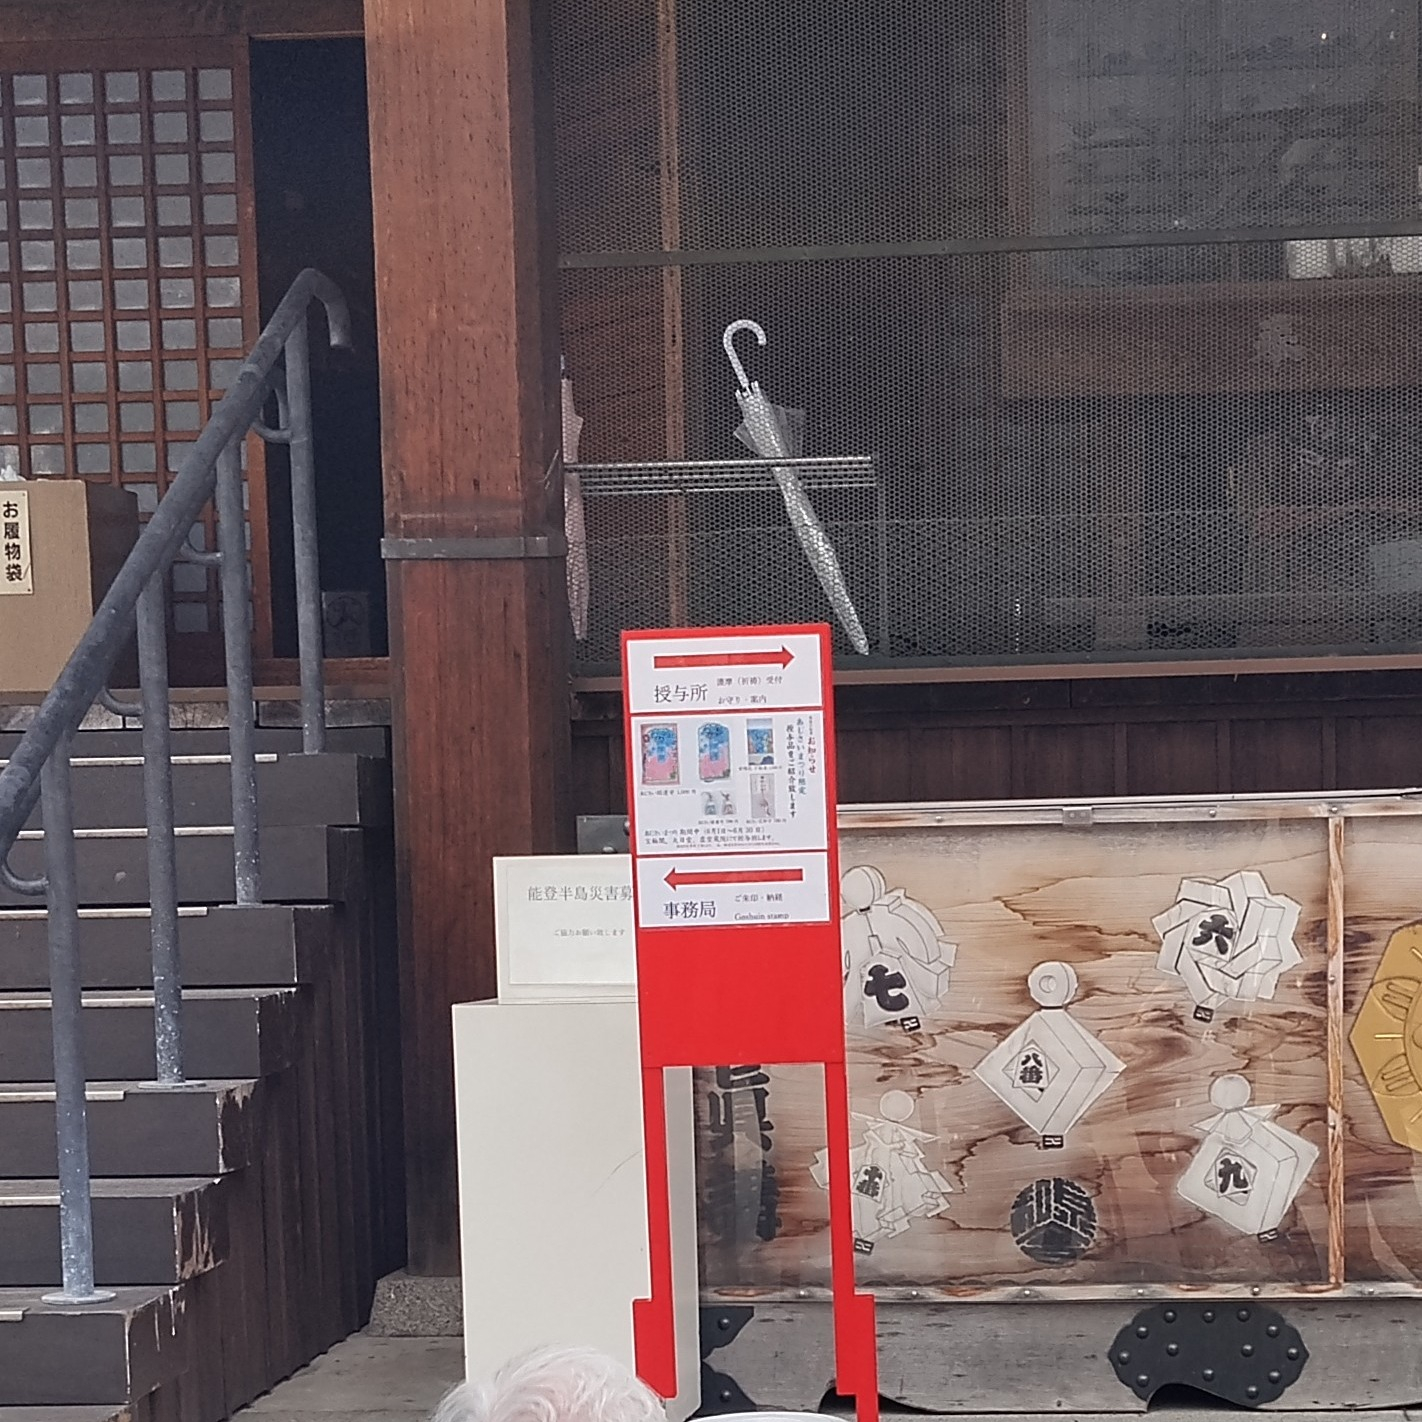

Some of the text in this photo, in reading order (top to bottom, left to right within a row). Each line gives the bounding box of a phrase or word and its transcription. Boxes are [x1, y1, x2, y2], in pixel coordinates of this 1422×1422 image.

[3, 501, 22, 582] お履物袋
[654, 684, 708, 703] 授与所
[664, 901, 716, 919] 事務局
[864, 964, 909, 1012] 七
